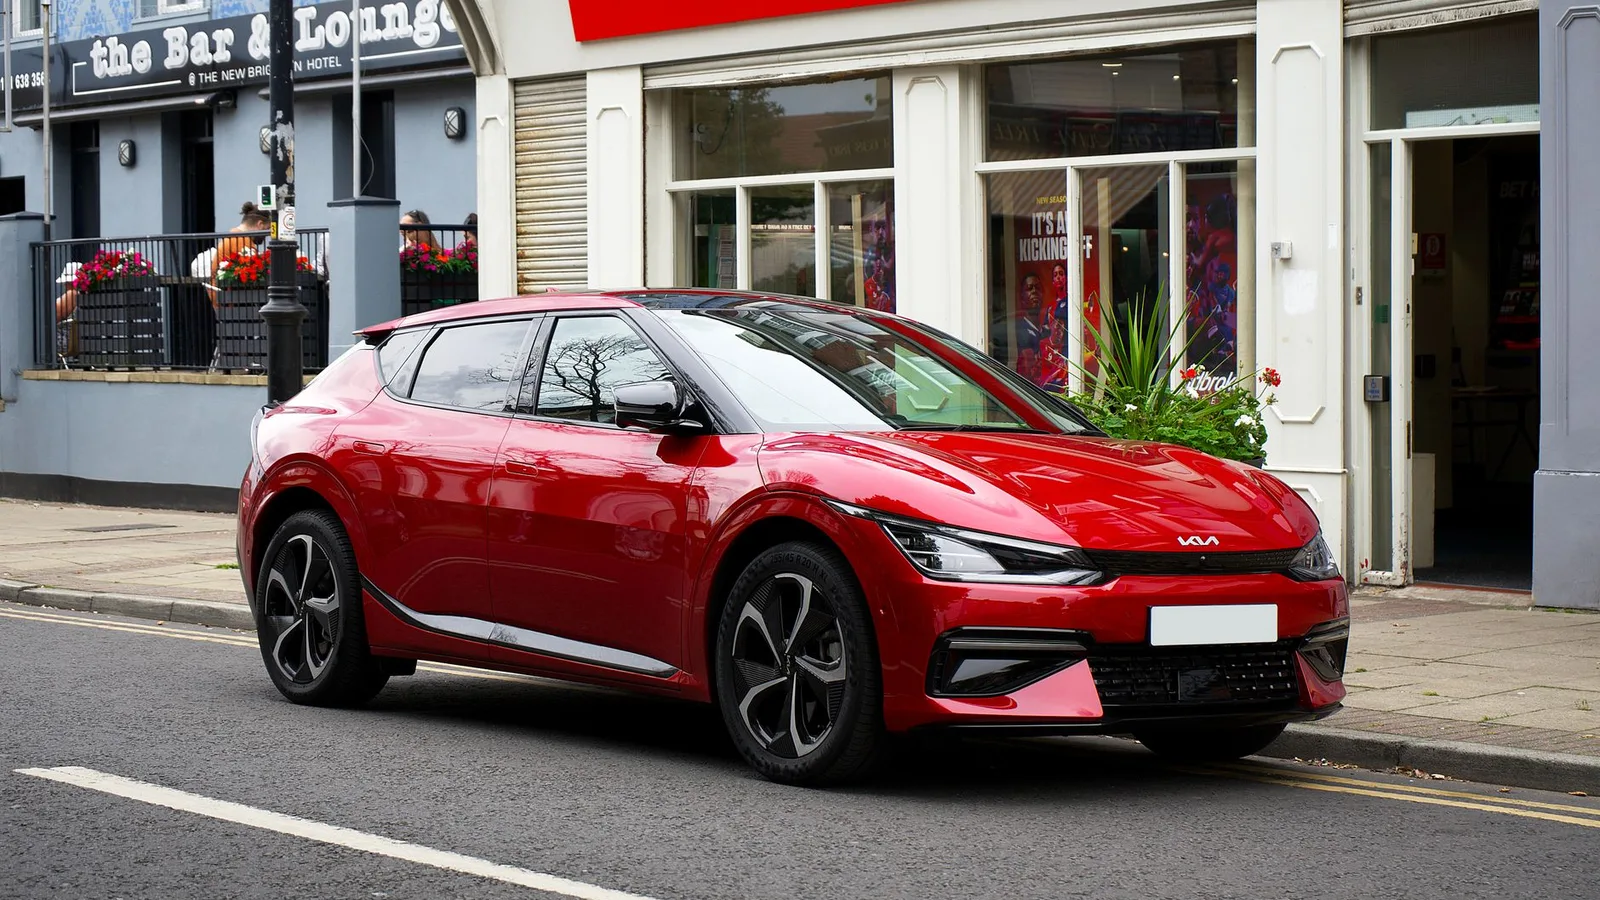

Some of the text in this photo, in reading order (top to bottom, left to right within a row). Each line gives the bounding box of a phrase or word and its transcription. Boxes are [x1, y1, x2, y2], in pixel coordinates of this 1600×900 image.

[90, 36, 152, 78] the
[163, 26, 235, 70] Bar
[248, 13, 270, 60] &
[15, 73, 30, 89] 638
[199, 71, 218, 83] THE
[221, 67, 246, 81] NEW
[248, 59, 303, 78] BRIGN
[307, 55, 342, 71] HOTEL
[1036, 195, 1067, 205] NEW SEASO
[1032, 210, 1054, 236] IT'S
[1019, 236, 1068, 262] KICKING
[1177, 536, 1220, 546] KIA
